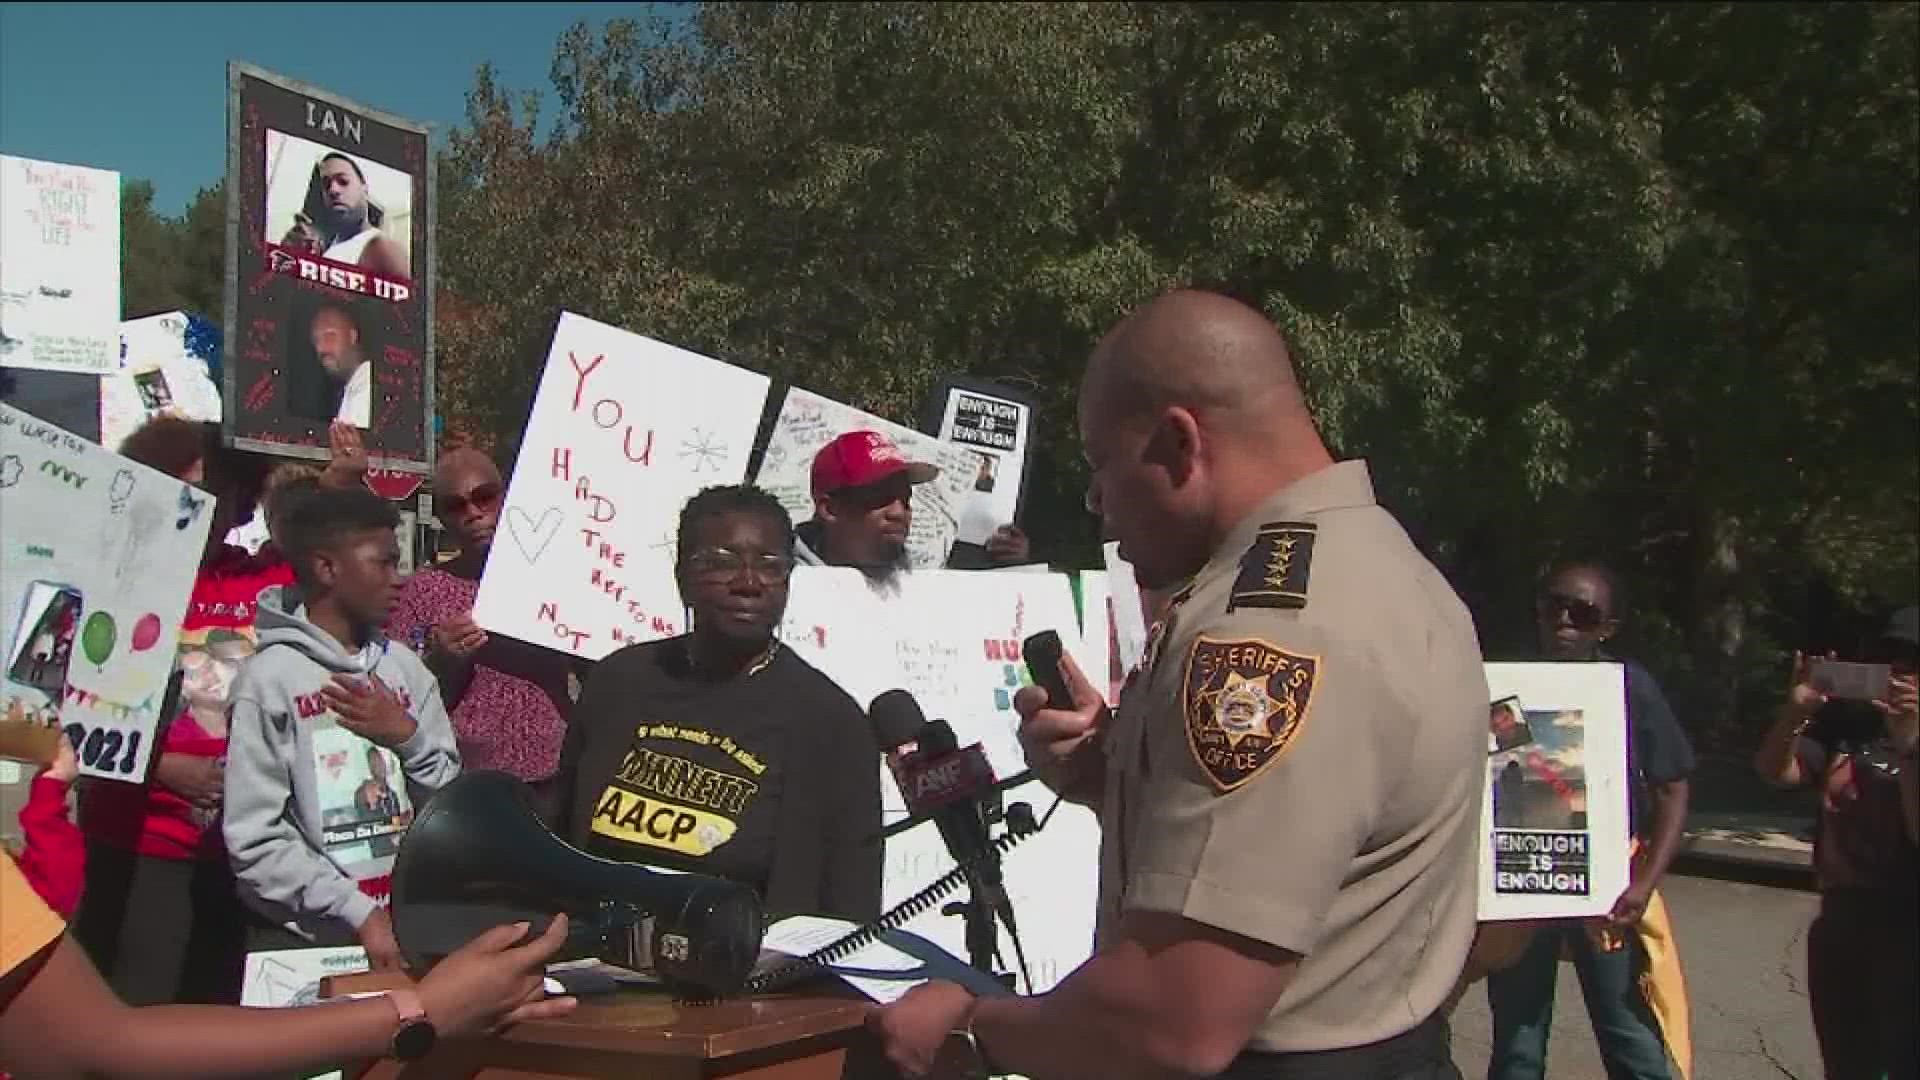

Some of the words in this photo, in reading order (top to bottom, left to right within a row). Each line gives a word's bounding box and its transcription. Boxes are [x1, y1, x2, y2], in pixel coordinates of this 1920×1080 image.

[303, 101, 362, 145] IAN
[298, 257, 367, 294] RISE
[373, 277, 409, 302] UP
[568, 350, 655, 467] YOU
[959, 396, 1018, 421] ENOUGH
[978, 414, 996, 430] IS
[953, 424, 1016, 449] ENOUGH
[551, 447, 617, 523] HAD
[580, 529, 626, 569] THE
[537, 602, 592, 651] NOT
[627, 599, 647, 624] TO
[1200, 646, 1308, 688] SHERIFF'S
[1205, 747, 1258, 770] OFFICE
[592, 790, 697, 843] AACP
[1496, 834, 1586, 853] ENOUGH
[1528, 854, 1553, 872] IS
[1496, 872, 1586, 892] ENOUGH
